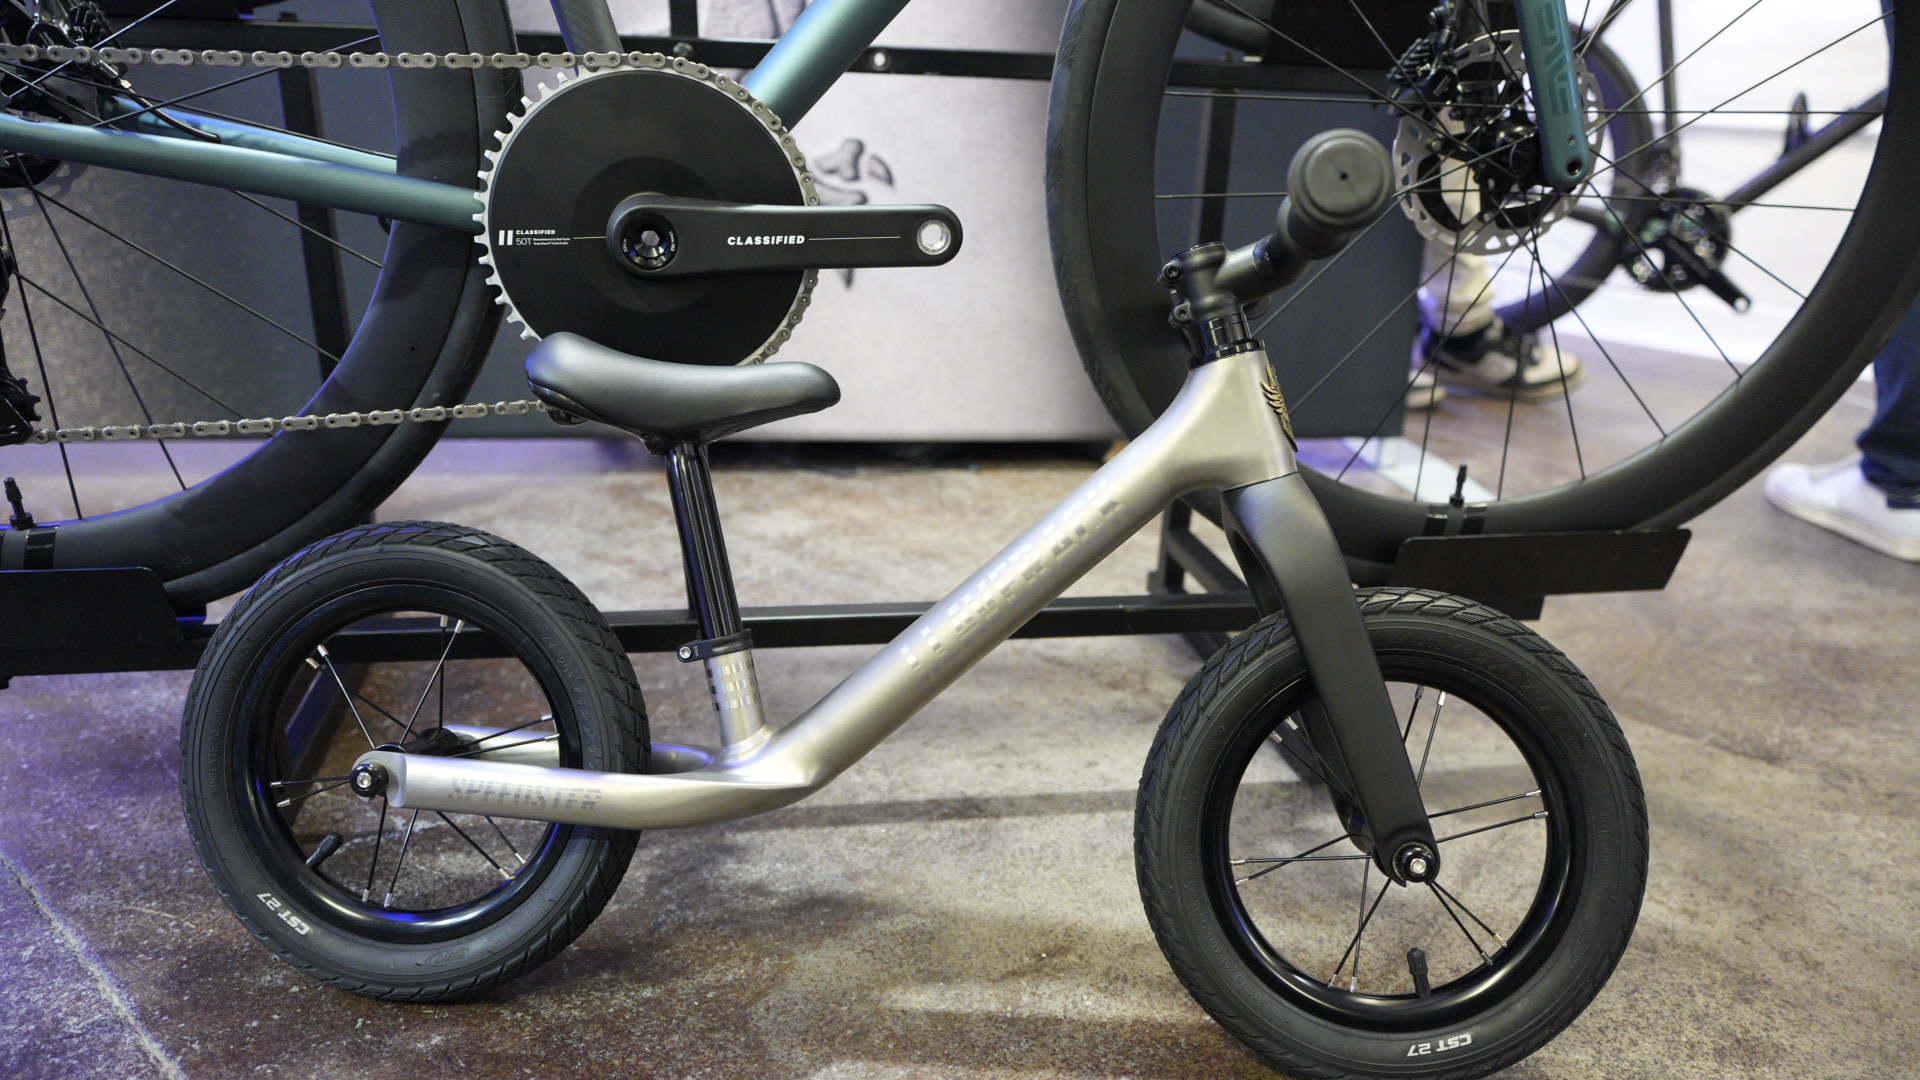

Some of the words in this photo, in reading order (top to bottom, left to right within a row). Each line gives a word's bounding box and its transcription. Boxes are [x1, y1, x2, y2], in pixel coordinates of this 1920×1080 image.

[516, 238, 532, 246] 50T
[727, 235, 806, 247] CLASSIFIED
[256, 892, 282, 911] 27
[277, 910, 310, 935] CST
[1406, 1042, 1432, 1057] 27
[1435, 1033, 1472, 1052] CST
